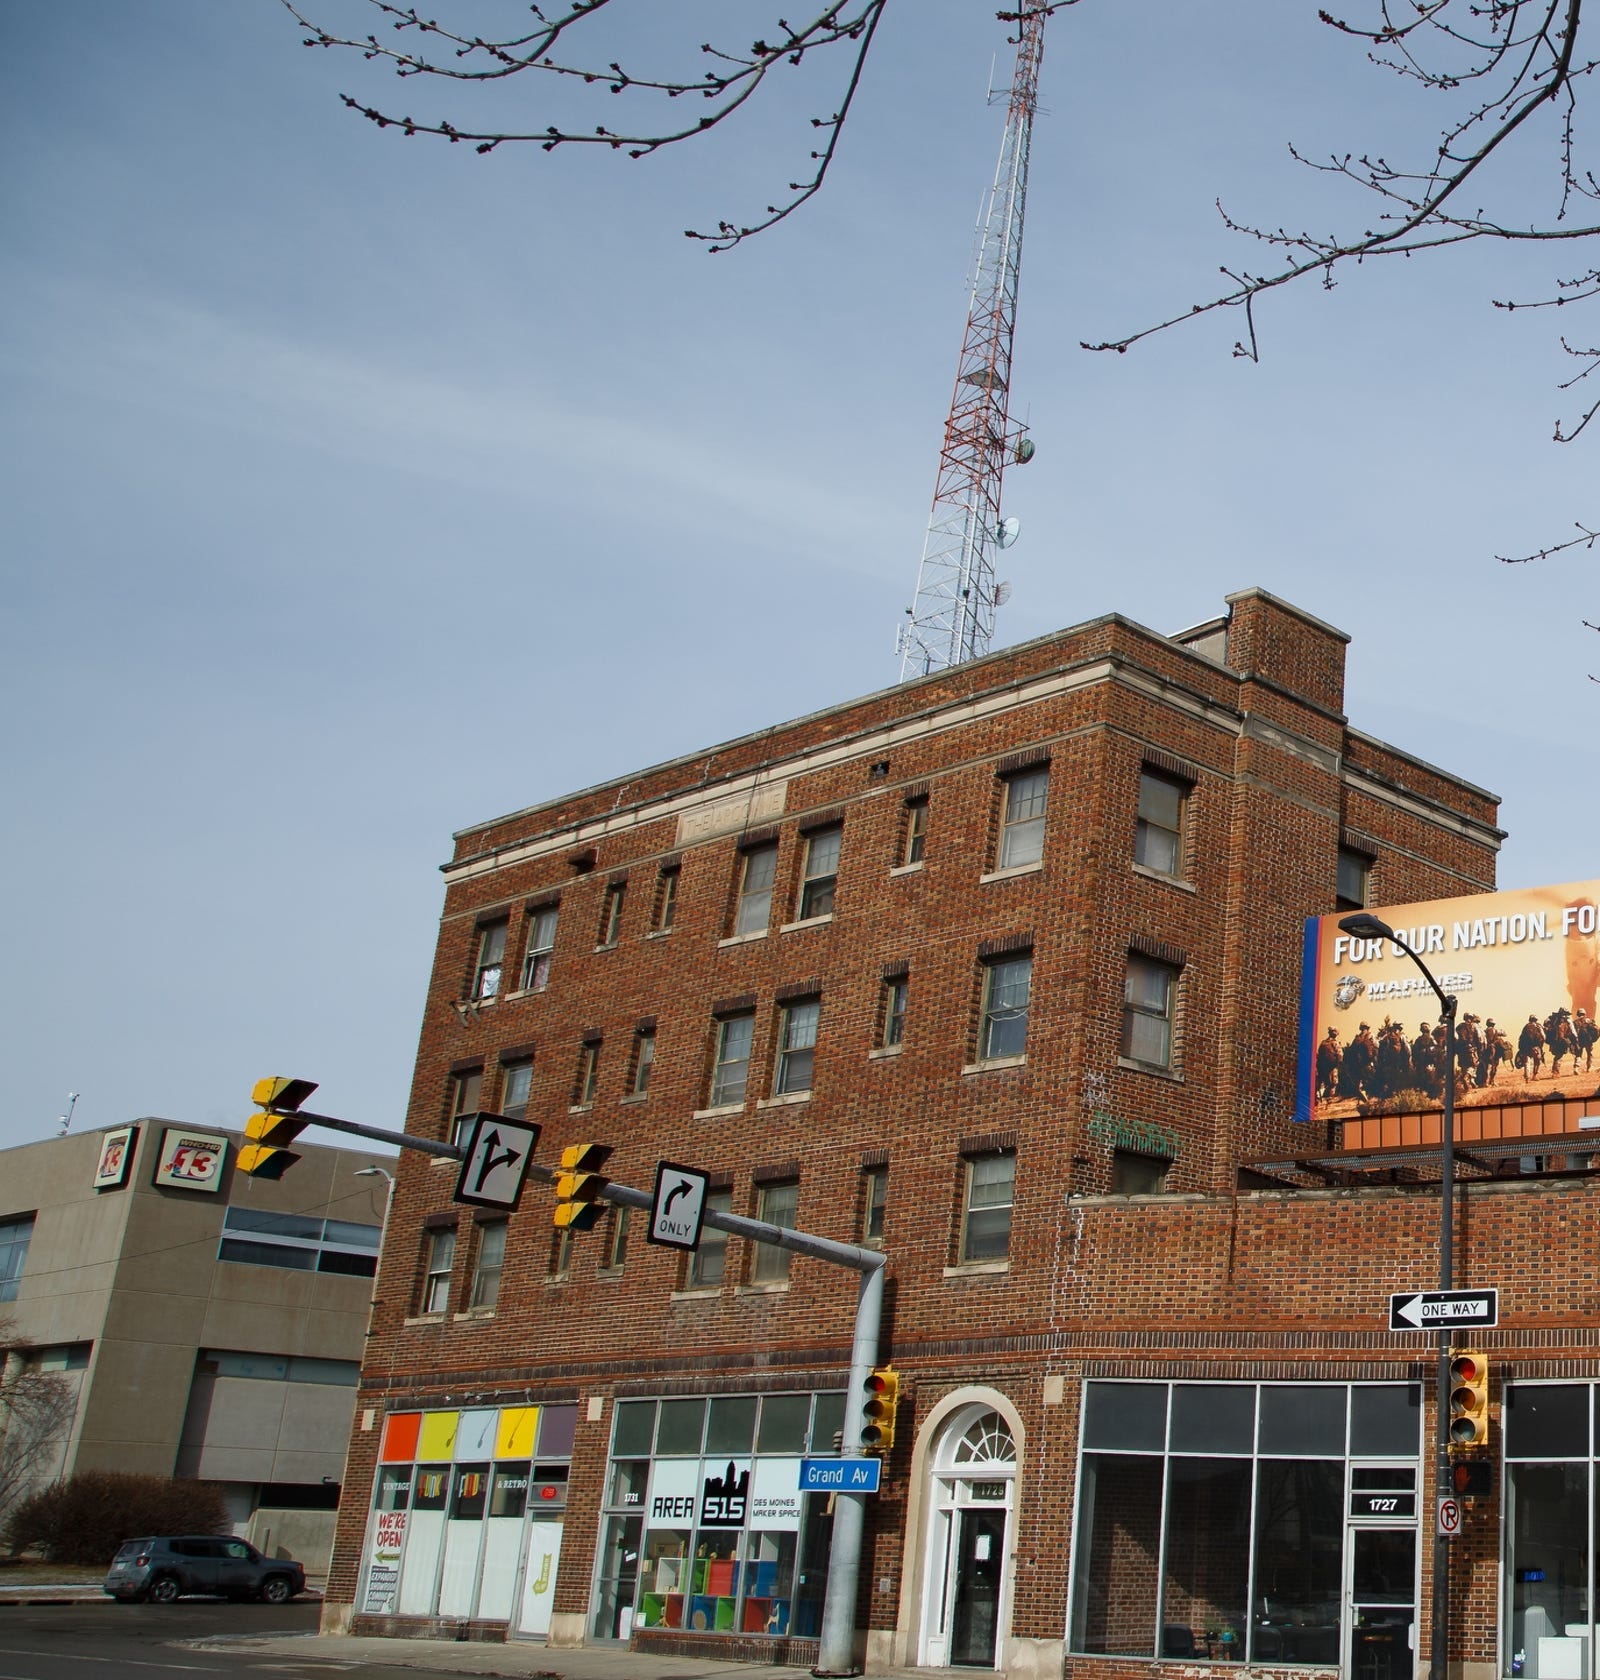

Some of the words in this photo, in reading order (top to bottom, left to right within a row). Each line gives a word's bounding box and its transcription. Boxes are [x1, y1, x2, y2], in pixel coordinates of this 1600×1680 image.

[1334, 934, 1383, 964] FOR
[1392, 925, 1445, 957] OUR
[1453, 912, 1553, 949] NATION.
[178, 1149, 218, 1178] 13
[659, 1219, 692, 1237] ONLY
[1421, 1303, 1448, 1318] ONE
[1452, 1301, 1479, 1316] WAY
[808, 1467, 843, 1483] Grand
[852, 1467, 868, 1483] Av
[503, 1480, 528, 1489] RETRO
[624, 1493, 638, 1503] 1731
[769, 1499, 795, 1507] MOINES
[1369, 1499, 1397, 1512] 1727
[653, 1497, 694, 1518] AREA
[704, 1497, 744, 1519] 515
[753, 1509, 777, 1518] MAKER
[778, 1510, 801, 1518] SPACE
[379, 1512, 407, 1529] WE'RE
[377, 1530, 402, 1547] OPEN
